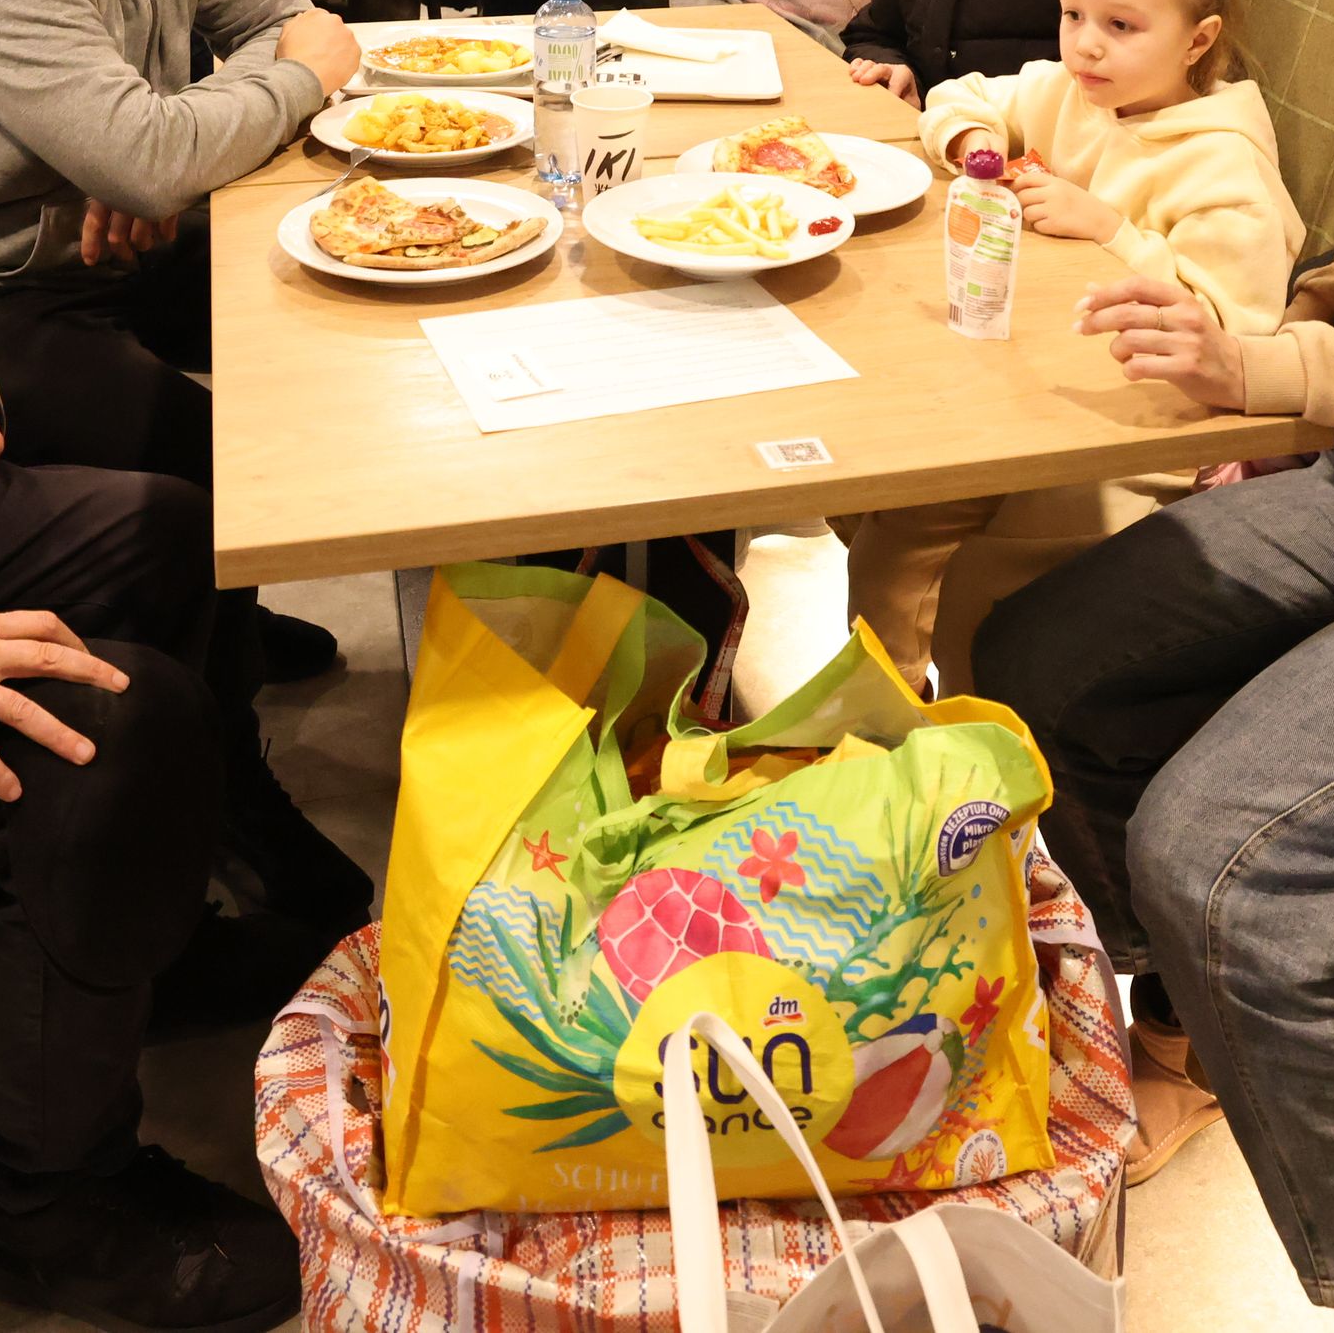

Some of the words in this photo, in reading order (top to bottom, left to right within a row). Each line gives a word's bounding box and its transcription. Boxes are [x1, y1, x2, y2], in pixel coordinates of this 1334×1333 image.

[584, 147, 637, 182] IKI
[945, 803, 987, 834] REZEPTUR
[769, 996, 799, 1017] dm
